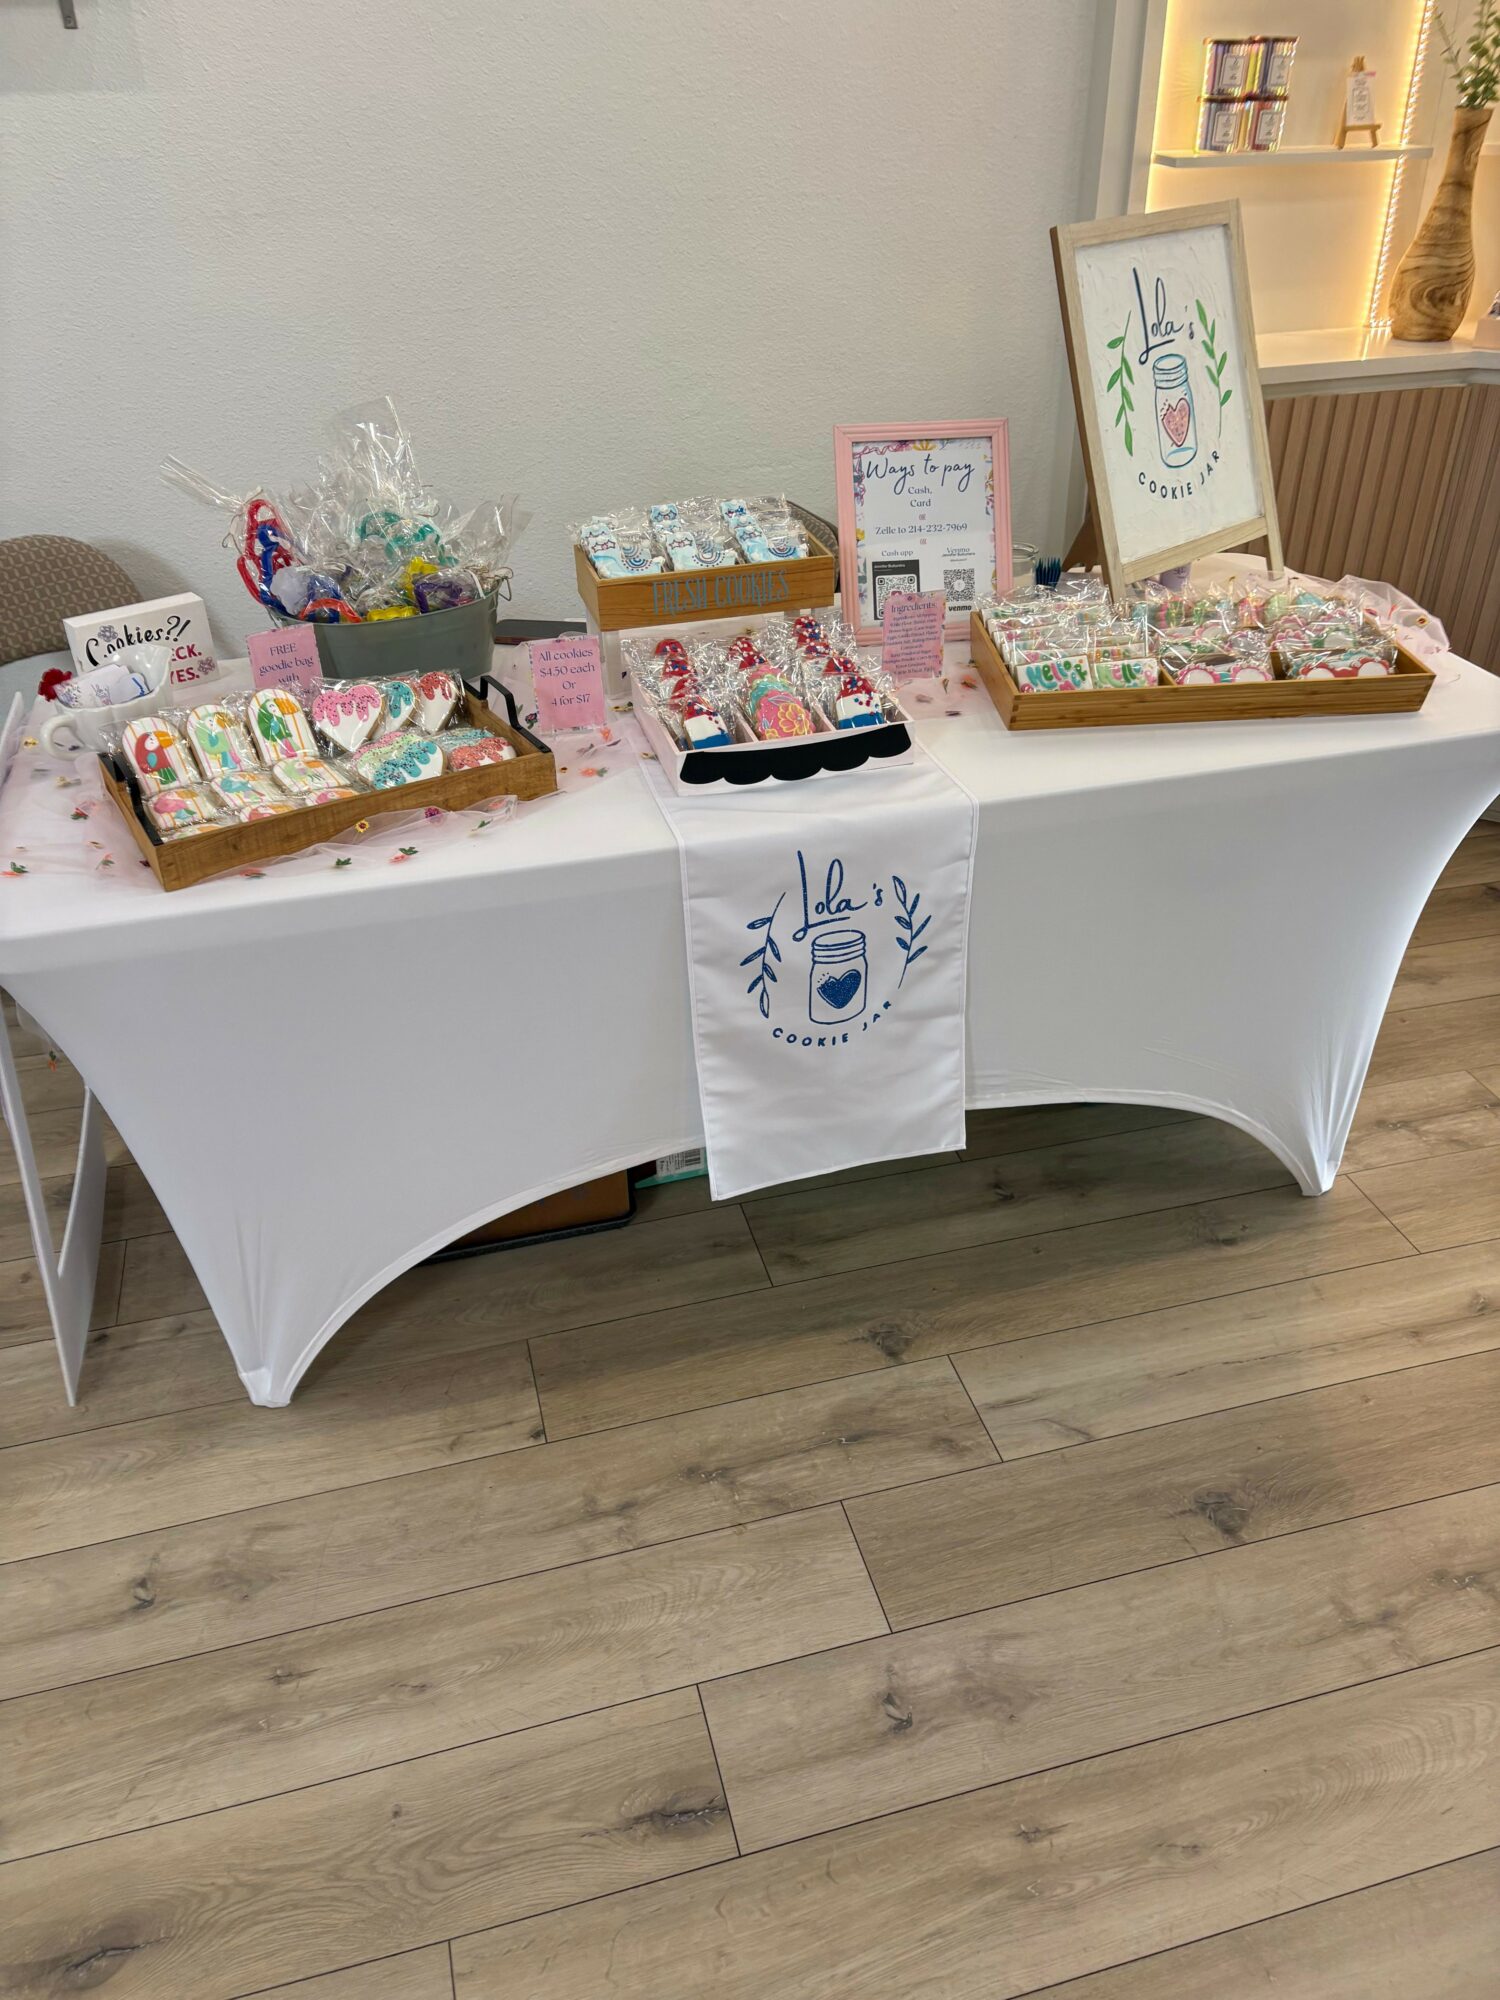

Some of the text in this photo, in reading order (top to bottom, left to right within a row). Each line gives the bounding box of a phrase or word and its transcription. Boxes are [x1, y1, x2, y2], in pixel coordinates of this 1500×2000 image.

[1133, 267, 1195, 365] Lola's
[866, 453, 975, 495] Ways to pay
[1138, 450, 1220, 500] COOKIE JAR
[908, 486, 932, 495] Cash,
[910, 499, 931, 508] Card
[875, 523, 968, 535] Zelle to 214-232-7969
[881, 549, 914, 557] Cash app
[653, 568, 789, 616] FRESH COOKIES
[948, 604, 972, 612] venmo
[85, 615, 191, 667] Cookies?!
[269, 643, 297, 656] FREE
[540, 648, 594, 661] All cookies
[259, 656, 314, 676] goodie bag
[570, 662, 596, 674] each
[562, 681, 577, 690] Or
[551, 693, 591, 706] 4 for $17
[792, 850, 884, 942] Lola's
[772, 1028, 850, 1047] COOKIE
